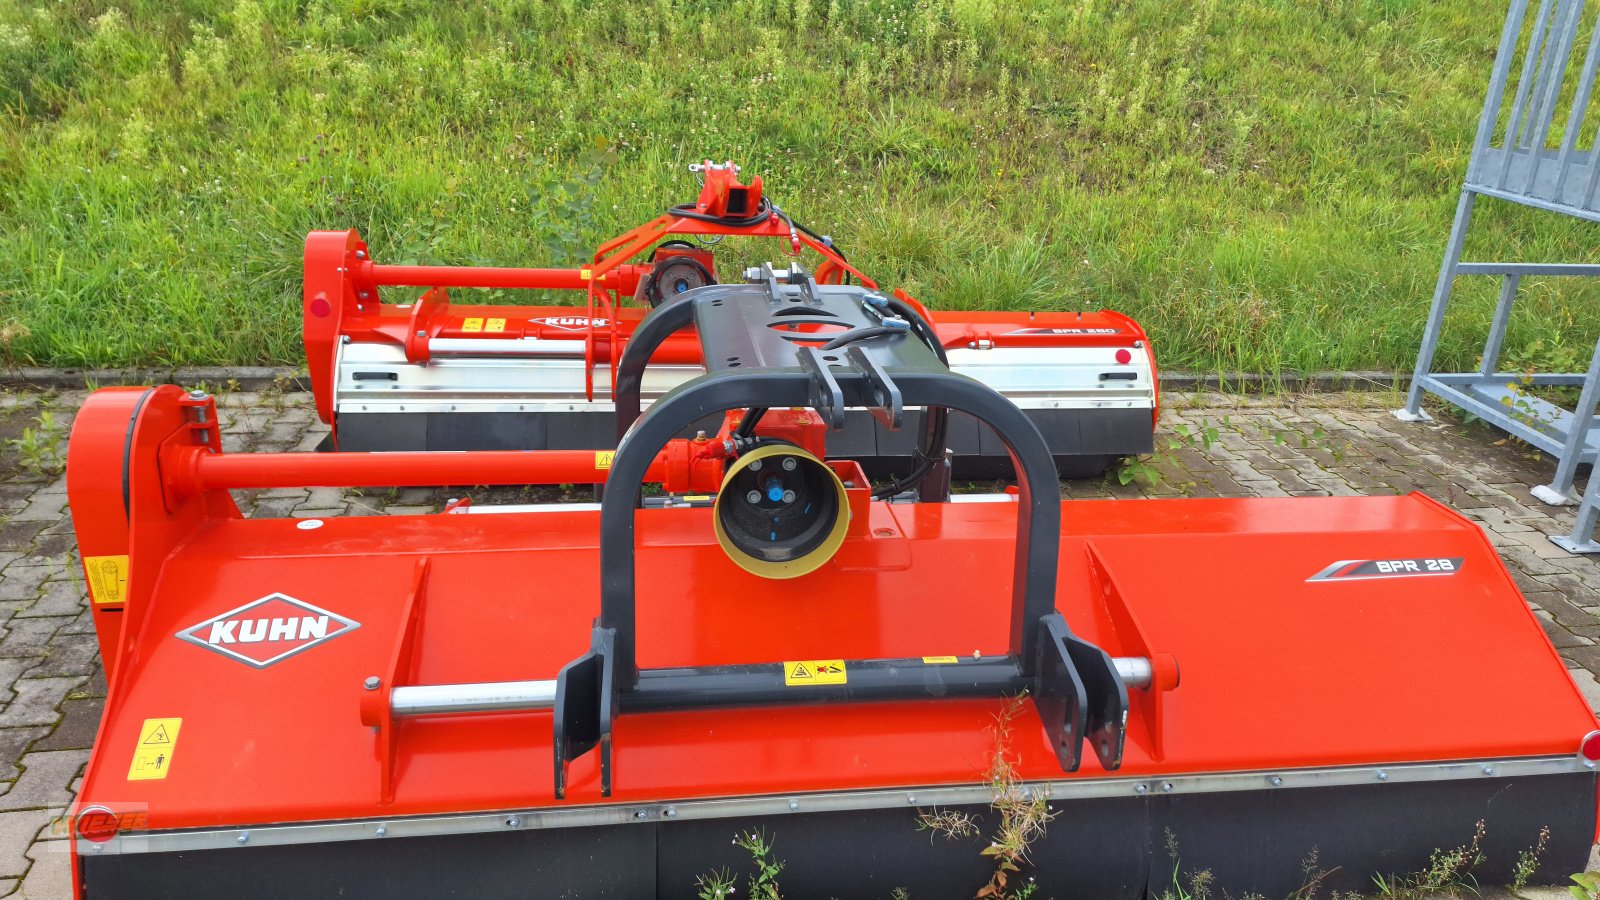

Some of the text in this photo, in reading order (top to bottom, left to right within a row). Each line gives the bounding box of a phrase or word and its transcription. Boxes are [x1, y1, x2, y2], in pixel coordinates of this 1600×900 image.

[544, 317, 605, 327] KUHN
[1375, 558, 1455, 573] BPR 28
[208, 615, 329, 645] KUHN
